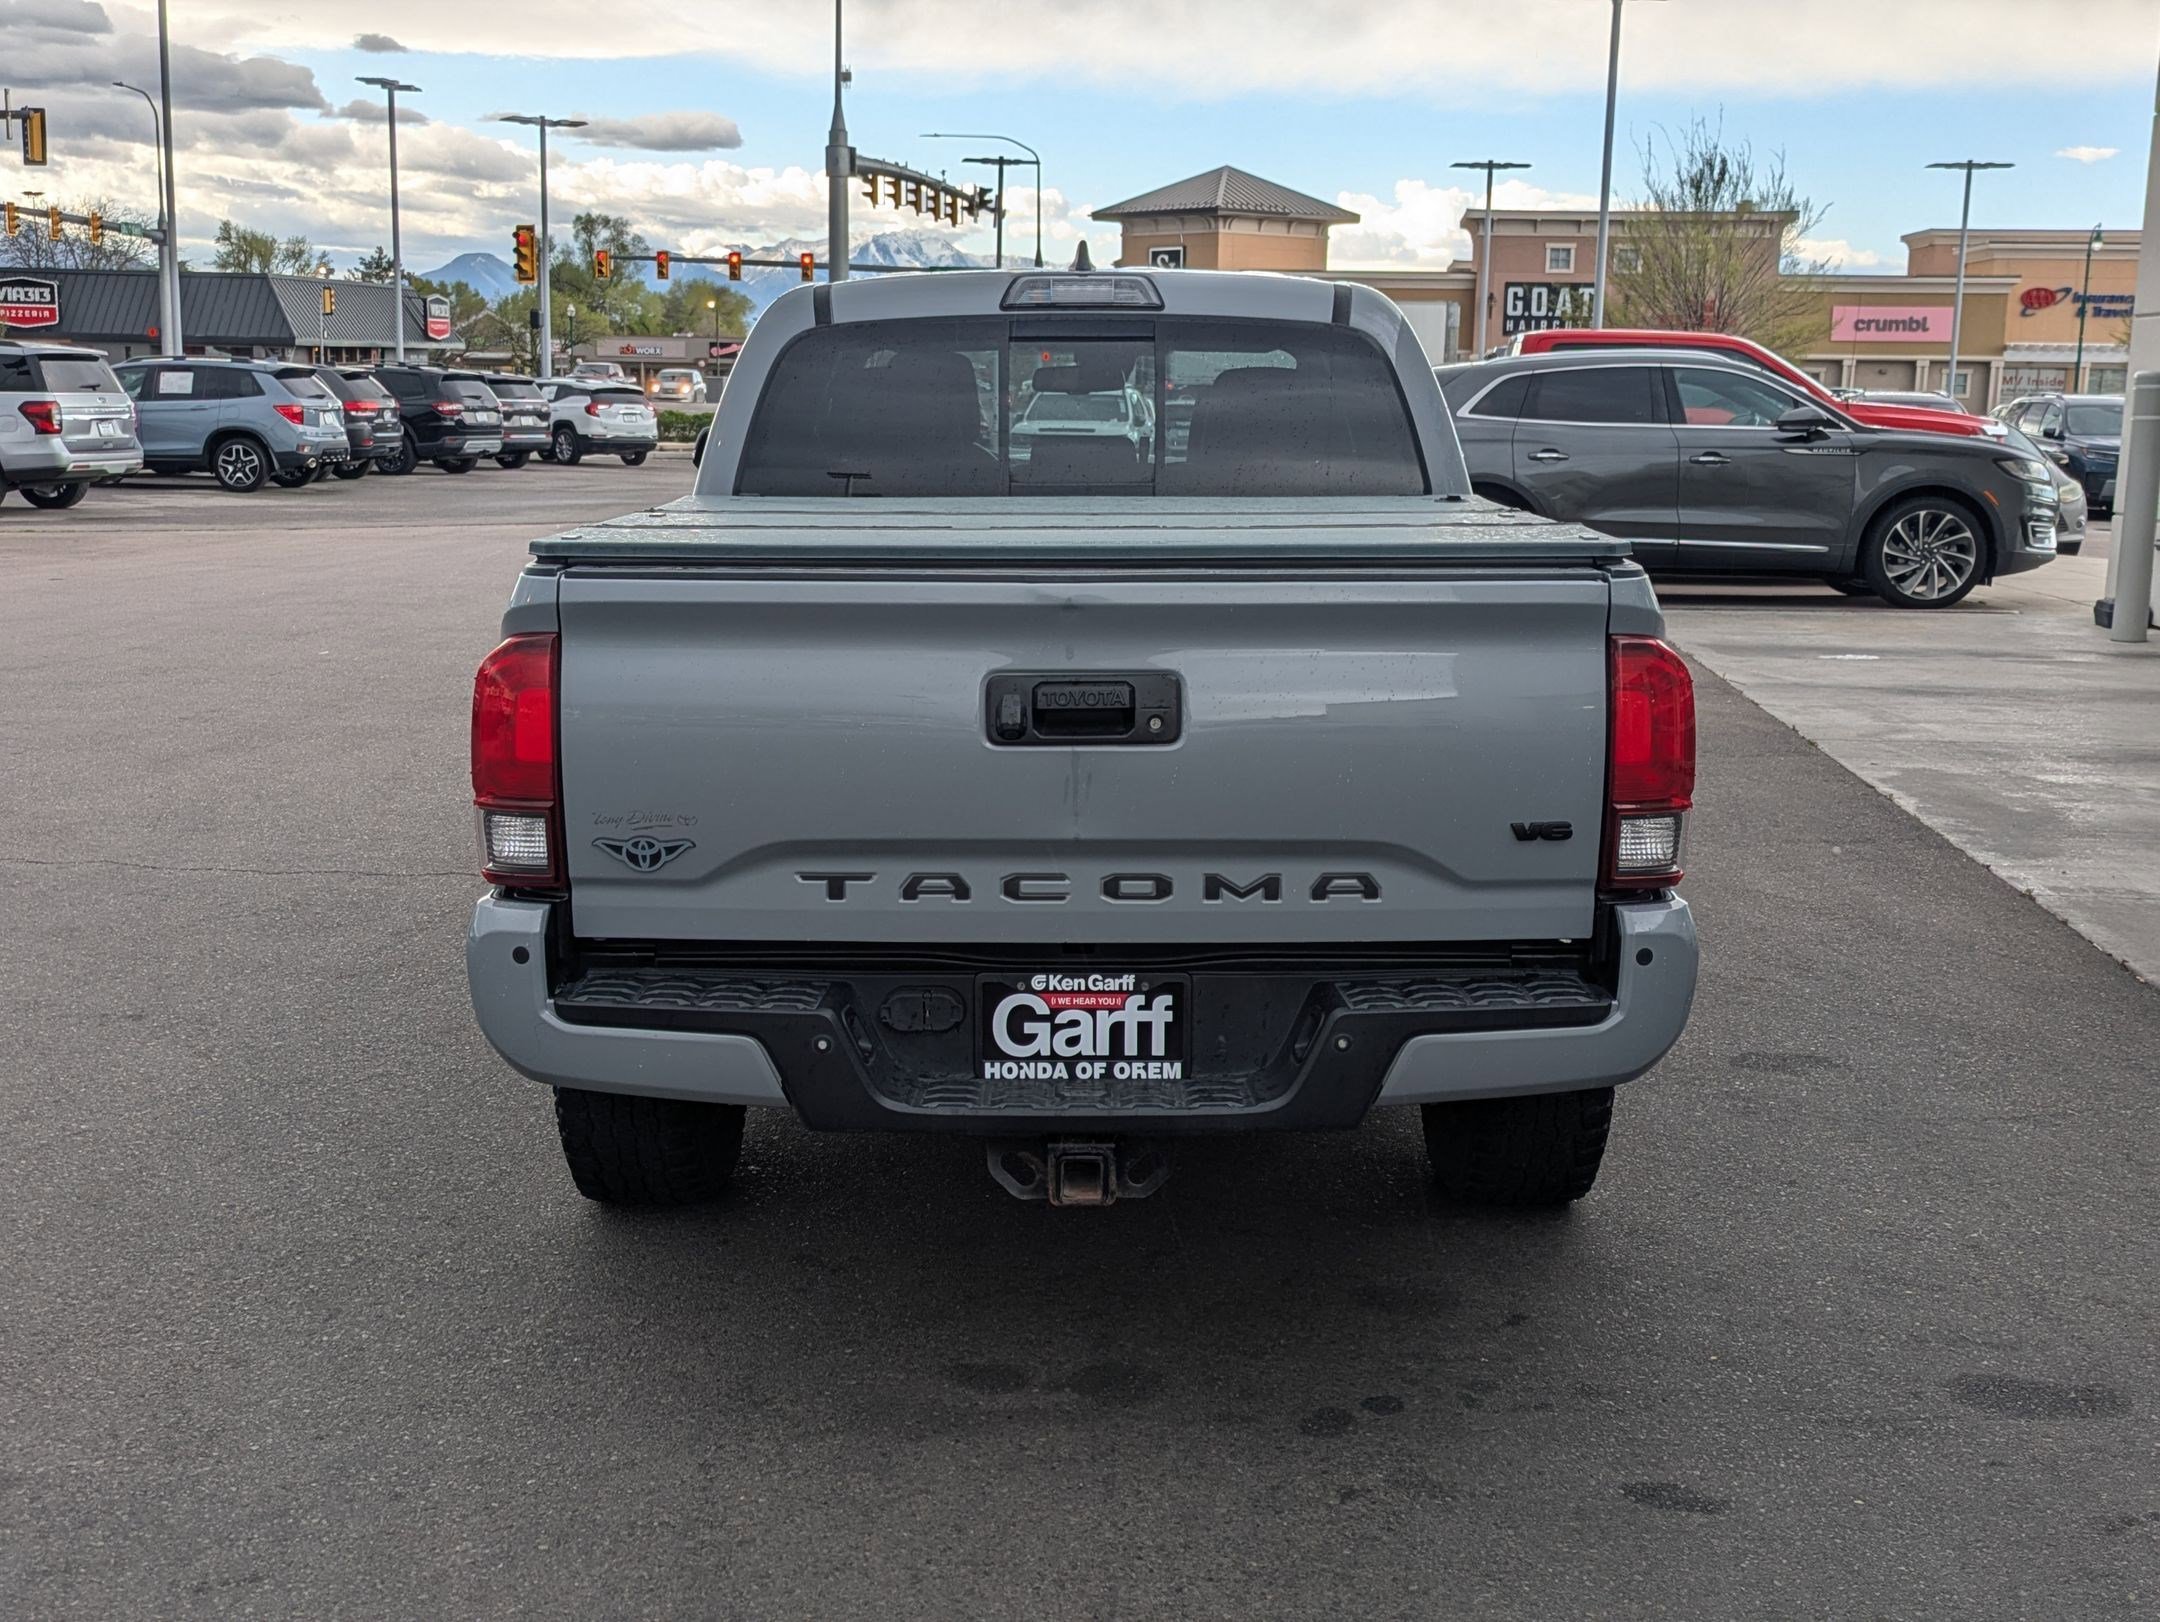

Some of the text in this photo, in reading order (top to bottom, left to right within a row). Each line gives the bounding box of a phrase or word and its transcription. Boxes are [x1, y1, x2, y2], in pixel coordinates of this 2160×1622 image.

[2073, 292, 2134, 303] Insuranc
[1854, 316, 1930, 333] crumbl
[618, 344, 662, 355] HOTWORX
[2027, 375, 2065, 387] Inside
[1041, 690, 1128, 706] TOYOTA
[1510, 821, 1573, 841] V6
[795, 871, 1382, 904] TACOMA
[1048, 974, 1136, 991] Ken Garff
[1057, 997, 1115, 1005] WE HEAR YOU
[992, 993, 1174, 1057] Garff
[984, 1062, 1182, 1080] HONDA OF OREM
